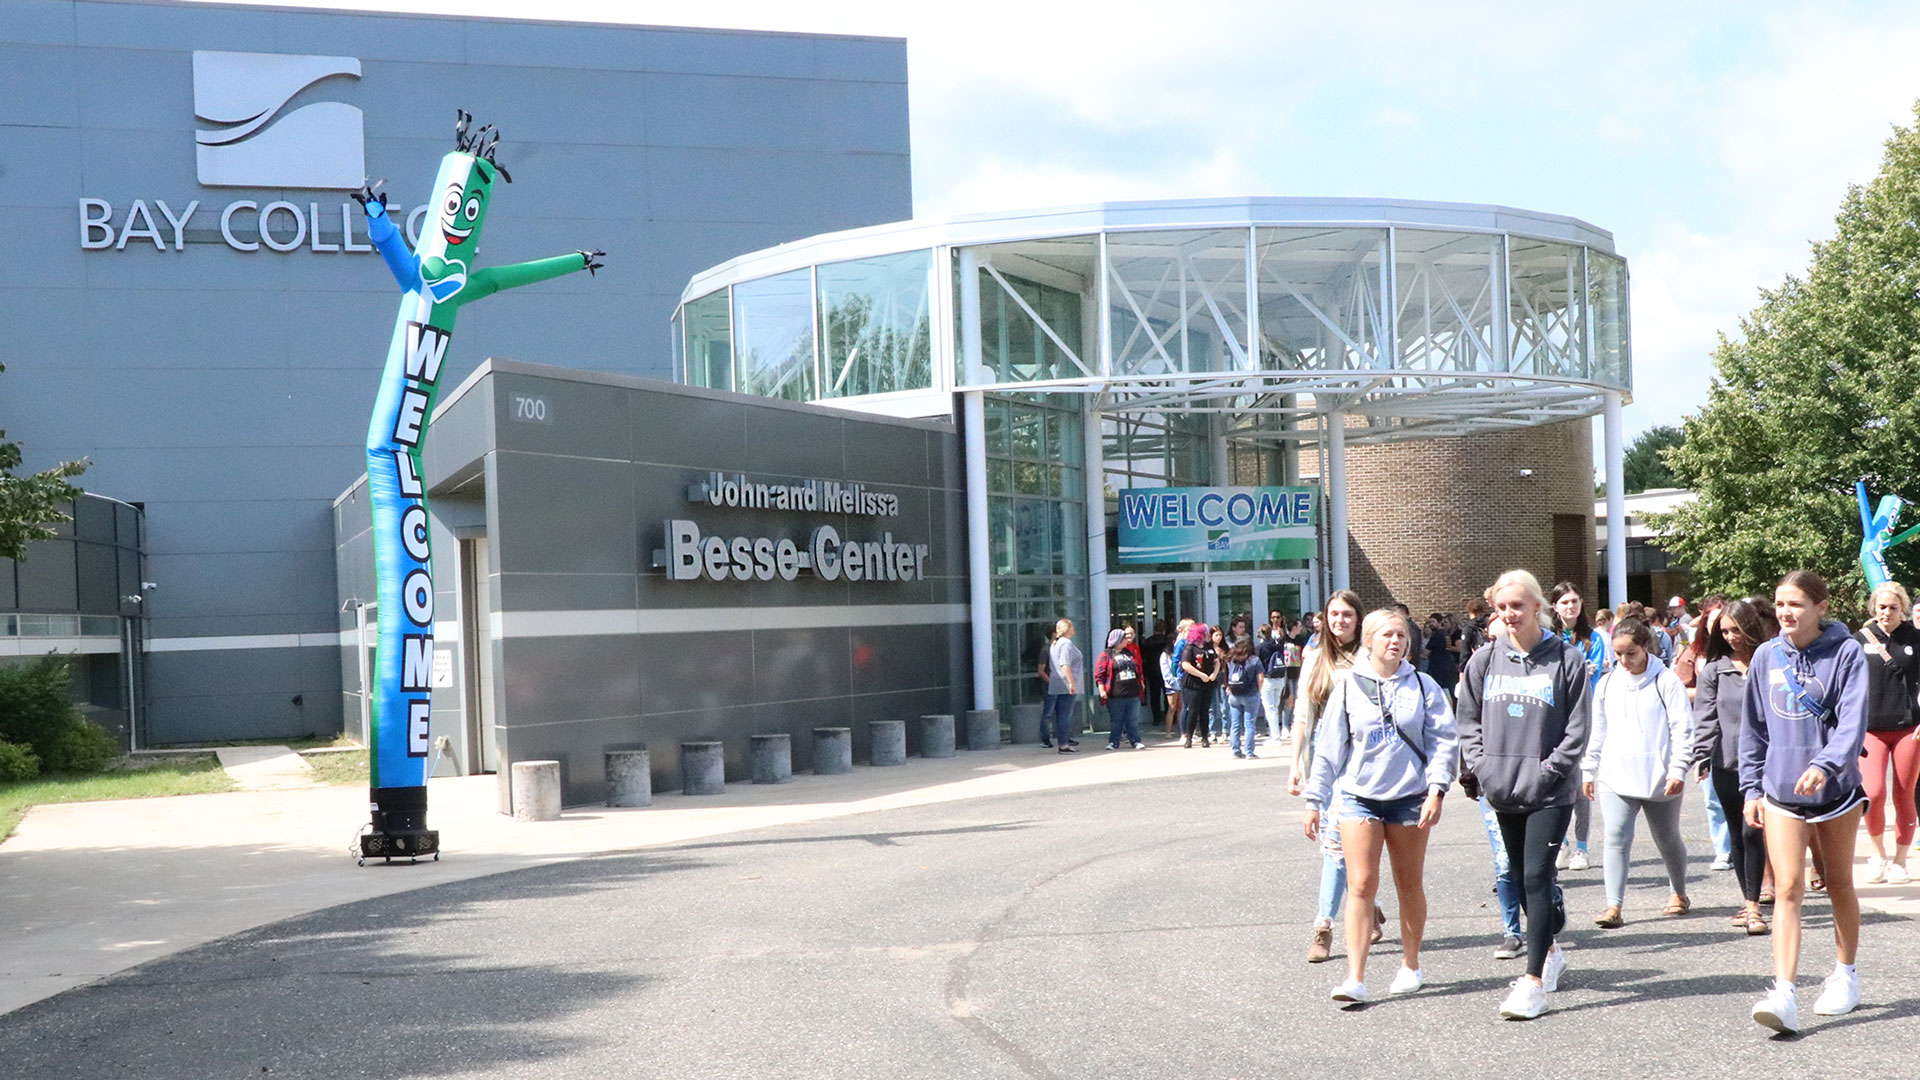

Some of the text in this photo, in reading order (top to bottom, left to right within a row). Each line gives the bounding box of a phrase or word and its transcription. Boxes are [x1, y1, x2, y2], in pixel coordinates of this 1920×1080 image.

[79, 198, 480, 255] BAY COLL
[516, 397, 546, 420] 700
[709, 472, 898, 516] John and Melissa
[1125, 492, 1311, 529] WELCOME
[392, 320, 451, 758] WELCOME
[667, 519, 928, 582] Besse Center
[1215, 541, 1230, 550] BAY
[1483, 674, 1554, 707] CAROLA
[1370, 729, 1404, 745] NORS
